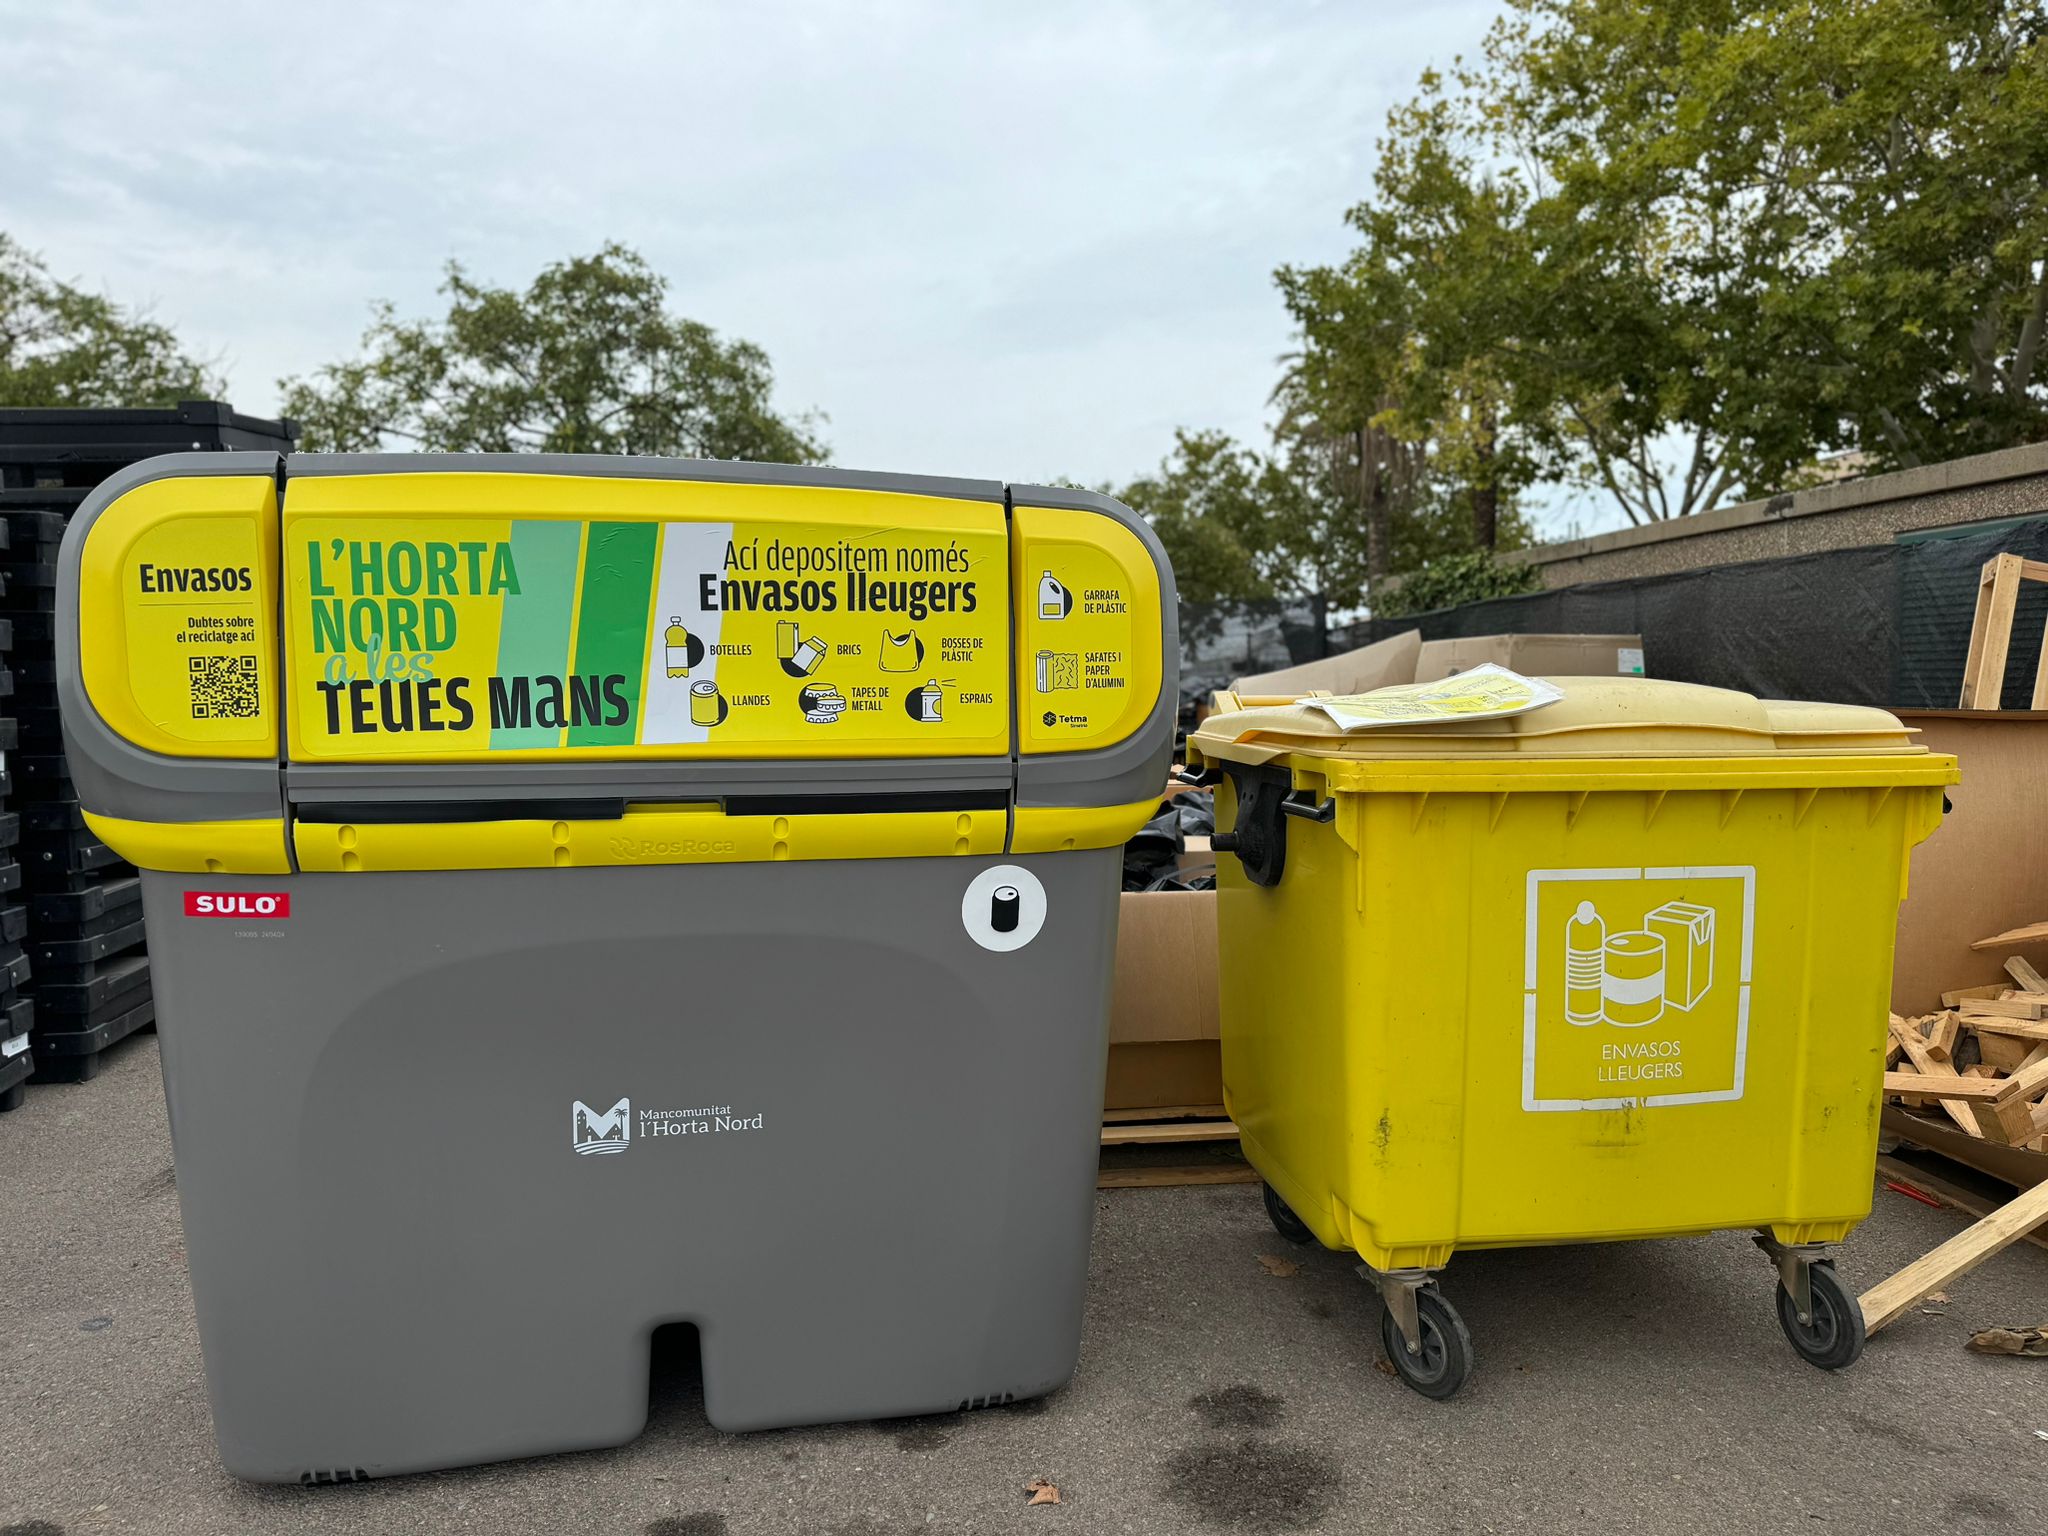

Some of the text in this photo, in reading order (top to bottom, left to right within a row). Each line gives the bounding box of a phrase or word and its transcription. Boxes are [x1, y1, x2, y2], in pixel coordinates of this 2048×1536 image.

[723, 537, 969, 578] Ací depositem només
[308, 538, 522, 596] L'HORTA
[139, 564, 252, 593] Envasos
[699, 572, 977, 621] Envasos lleugers
[1084, 589, 1120, 601] GARRAFA
[1084, 600, 1127, 614] DE PLÀSTIC
[188, 616, 254, 628] Dubtes sobre
[311, 597, 457, 653] NORD
[176, 631, 186, 643] el
[188, 630, 238, 644] reciclatge
[941, 637, 983, 649] BOSSES DE
[710, 644, 752, 656] BOTELLES
[837, 644, 862, 656] BRICS
[941, 649, 973, 662] PLÀSTIC
[324, 632, 435, 686] a les
[1084, 652, 1122, 663] SAFATES I
[1085, 665, 1110, 676] PAPER
[1085, 677, 1125, 689] D'ALUMINI
[851, 687, 889, 698] TAPES DE
[960, 693, 993, 704] ESPRAIS
[732, 695, 771, 706] LLANDES
[851, 700, 883, 711] METALL
[1059, 715, 1088, 723] Tetma
[639, 839, 737, 856] RosRoca
[1602, 1040, 1681, 1060] ENVASOS
[1598, 1061, 1683, 1082] LLEUGERS
[640, 1104, 732, 1120] Mancomunitat
[715, 1113, 763, 1132] Nord
